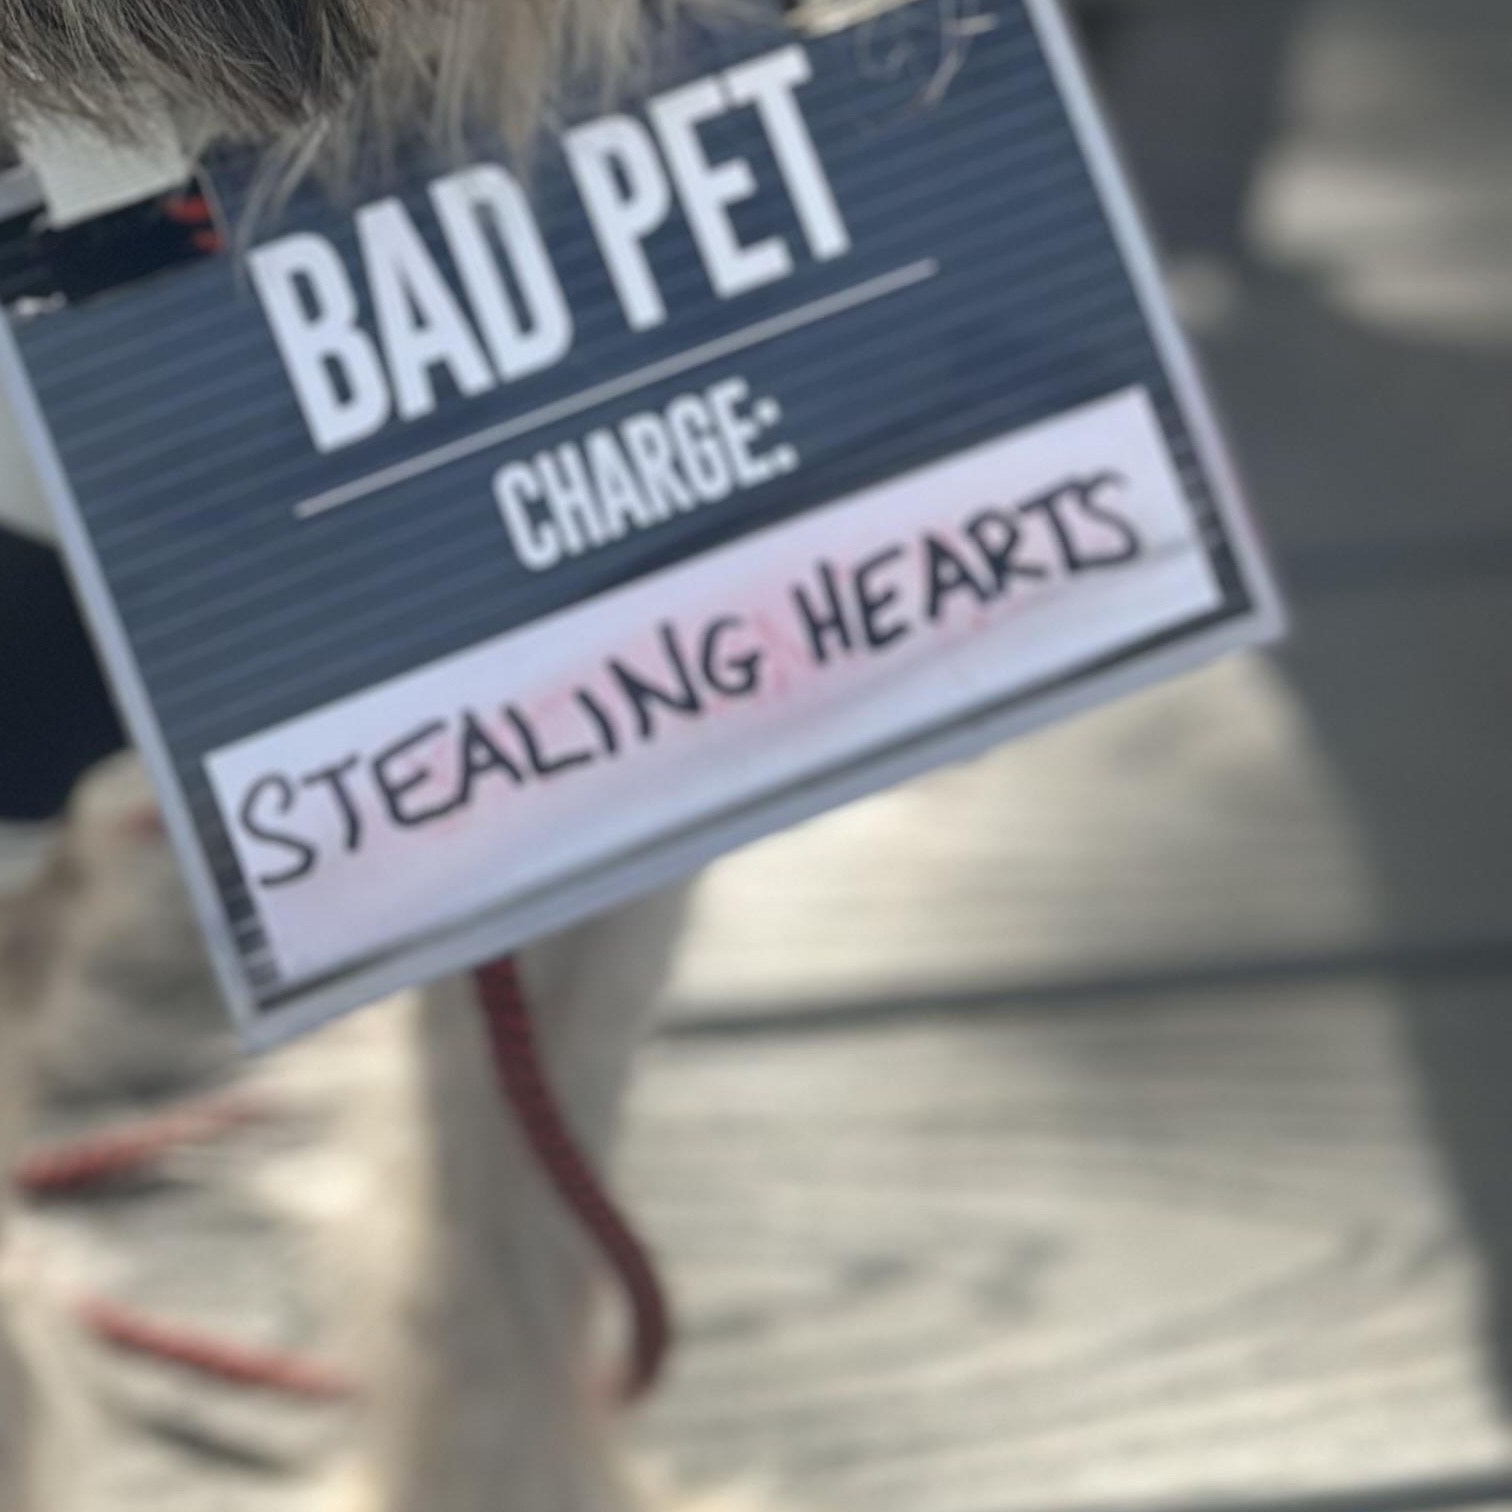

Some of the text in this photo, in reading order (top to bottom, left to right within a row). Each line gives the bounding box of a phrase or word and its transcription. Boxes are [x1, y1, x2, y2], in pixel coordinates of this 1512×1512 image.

[247, 45, 850, 453] BAD PET
[493, 375, 799, 571] CHARGE:
[240, 473, 1141, 887] STEALING HEARTS
